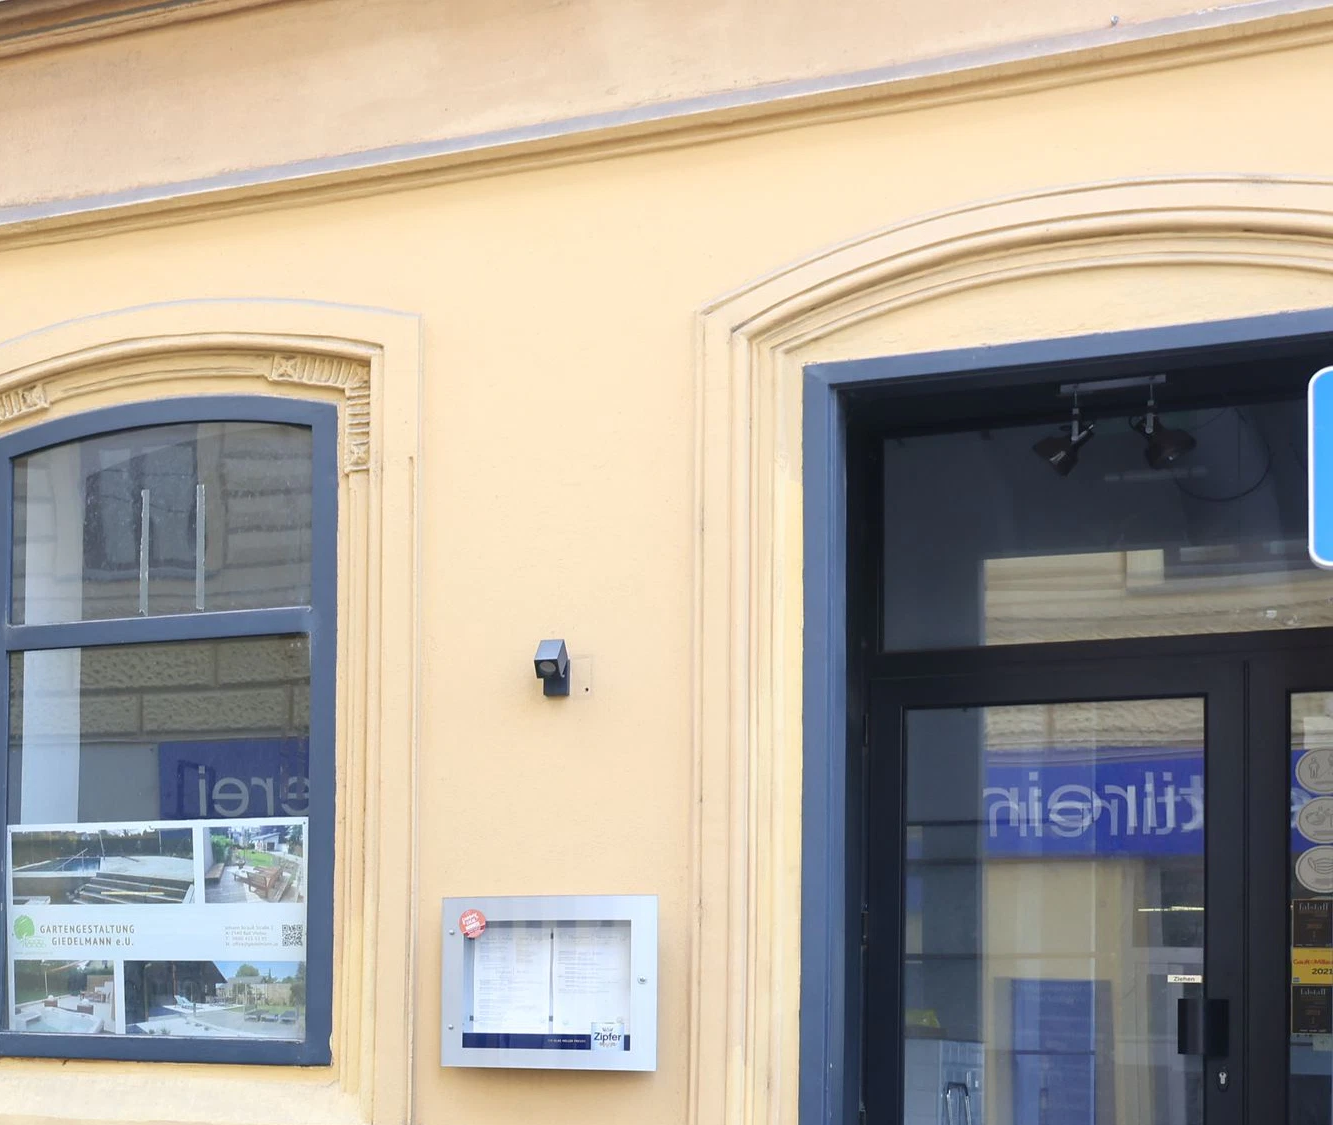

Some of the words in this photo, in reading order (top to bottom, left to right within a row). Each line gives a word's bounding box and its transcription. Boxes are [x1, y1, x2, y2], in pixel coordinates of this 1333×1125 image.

[40, 924, 135, 934] GARTENGESTALTUNG
[51, 937, 112, 946] GIEDELMANN
[115, 938, 134, 946] e.U.
[594, 1032, 621, 1043] Zipfer
